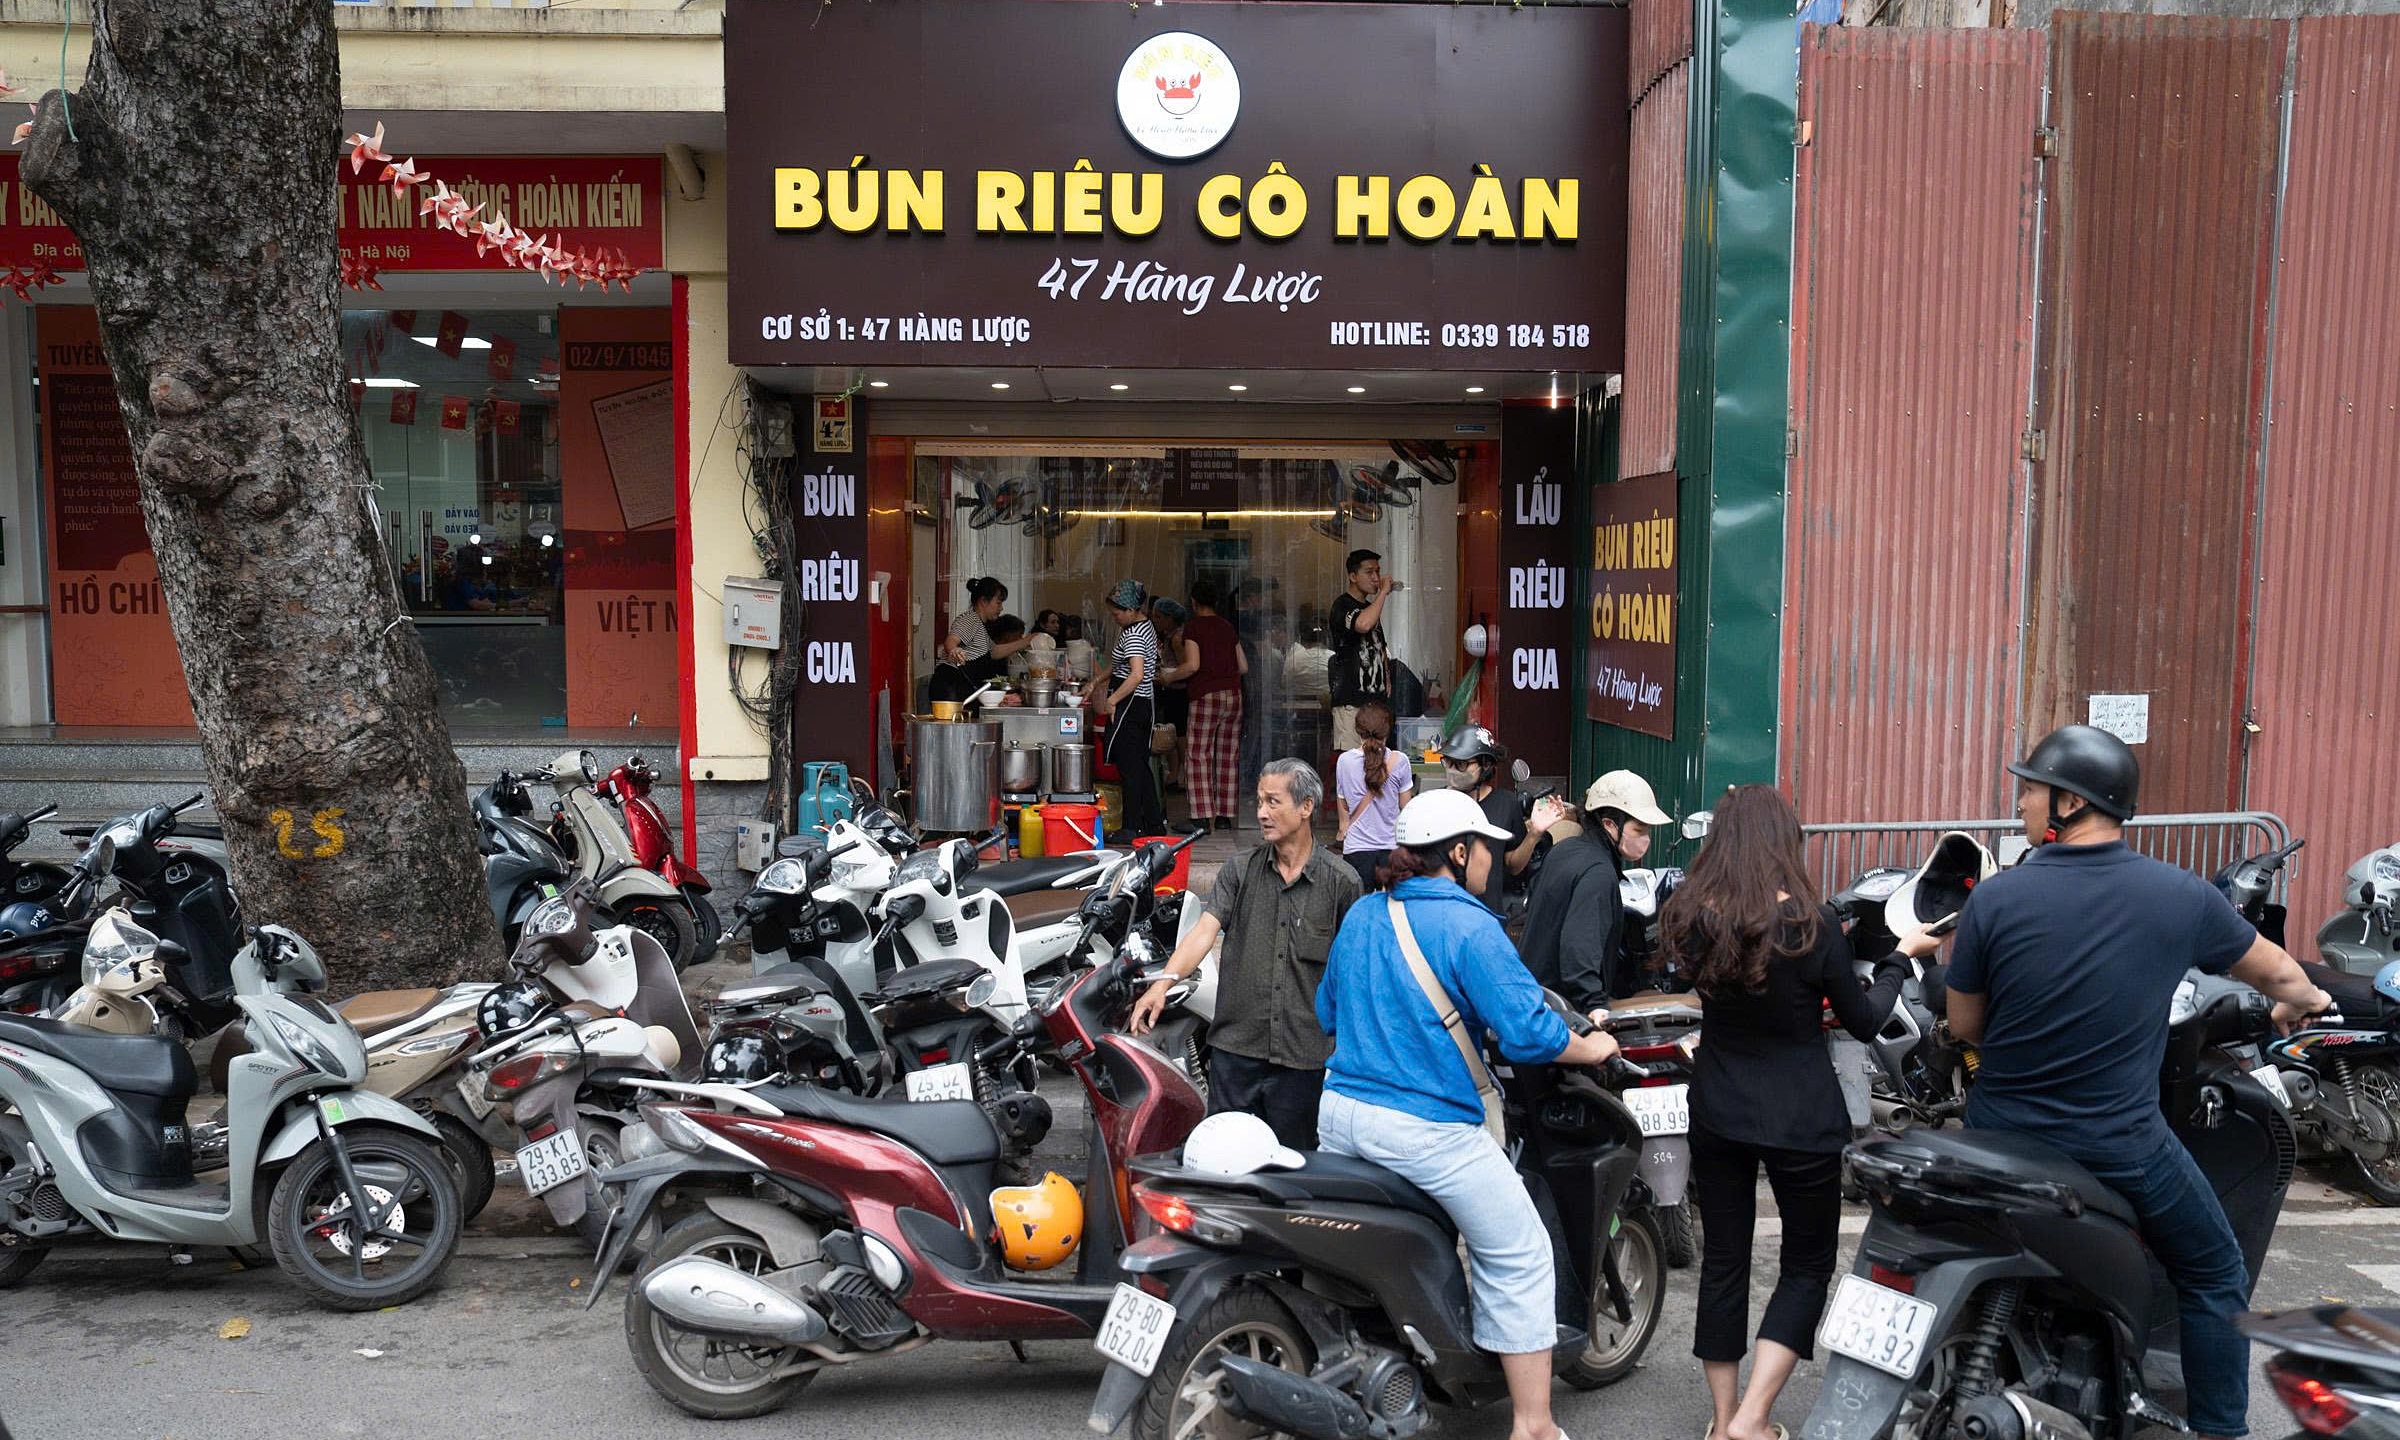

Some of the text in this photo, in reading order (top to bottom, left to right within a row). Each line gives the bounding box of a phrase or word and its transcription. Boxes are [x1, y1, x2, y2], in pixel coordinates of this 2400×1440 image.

[357, 184, 412, 229] NAM
[519, 174, 580, 228] HOÀN
[587, 170, 642, 227] KIẾM
[774, 155, 1580, 241] BÚN RIÊU CÔ HOÀN
[64, 243, 82, 257] ch
[360, 244, 380, 258] Hà
[385, 244, 411, 261] Nội
[1037, 257, 1323, 316] 47 Hàng Lược
[762, 308, 1031, 347] CƠ SỞ 1: 47 HÀNG LƯỢC
[1331, 321, 1590, 348] HOTLINE: 0339 184 518
[570, 345, 671, 368] 02/9/1945
[820, 421, 847, 438] 47
[803, 465, 856, 517] BÚN
[1515, 465, 1562, 526] LẨU
[1594, 508, 1673, 571] BÚN RIÊU
[60, 574, 161, 615] HỒ CHÍ
[801, 550, 859, 601] RIÊU
[1509, 558, 1566, 609] RIÊU
[597, 594, 657, 639] VIỆT
[1592, 583, 1671, 644] CÔ HOÀN
[807, 641, 857, 684] CUA
[1512, 647, 1560, 690] CUA
[1596, 665, 1664, 713] 47 Hàng Lược
[269, 806, 346, 859] 25
[1635, 1110, 1688, 1132] 88.99
[524, 1134, 571, 1167] 29-K1
[530, 1153, 582, 1191] 433.85
[1102, 1321, 1154, 1369] 162.04
